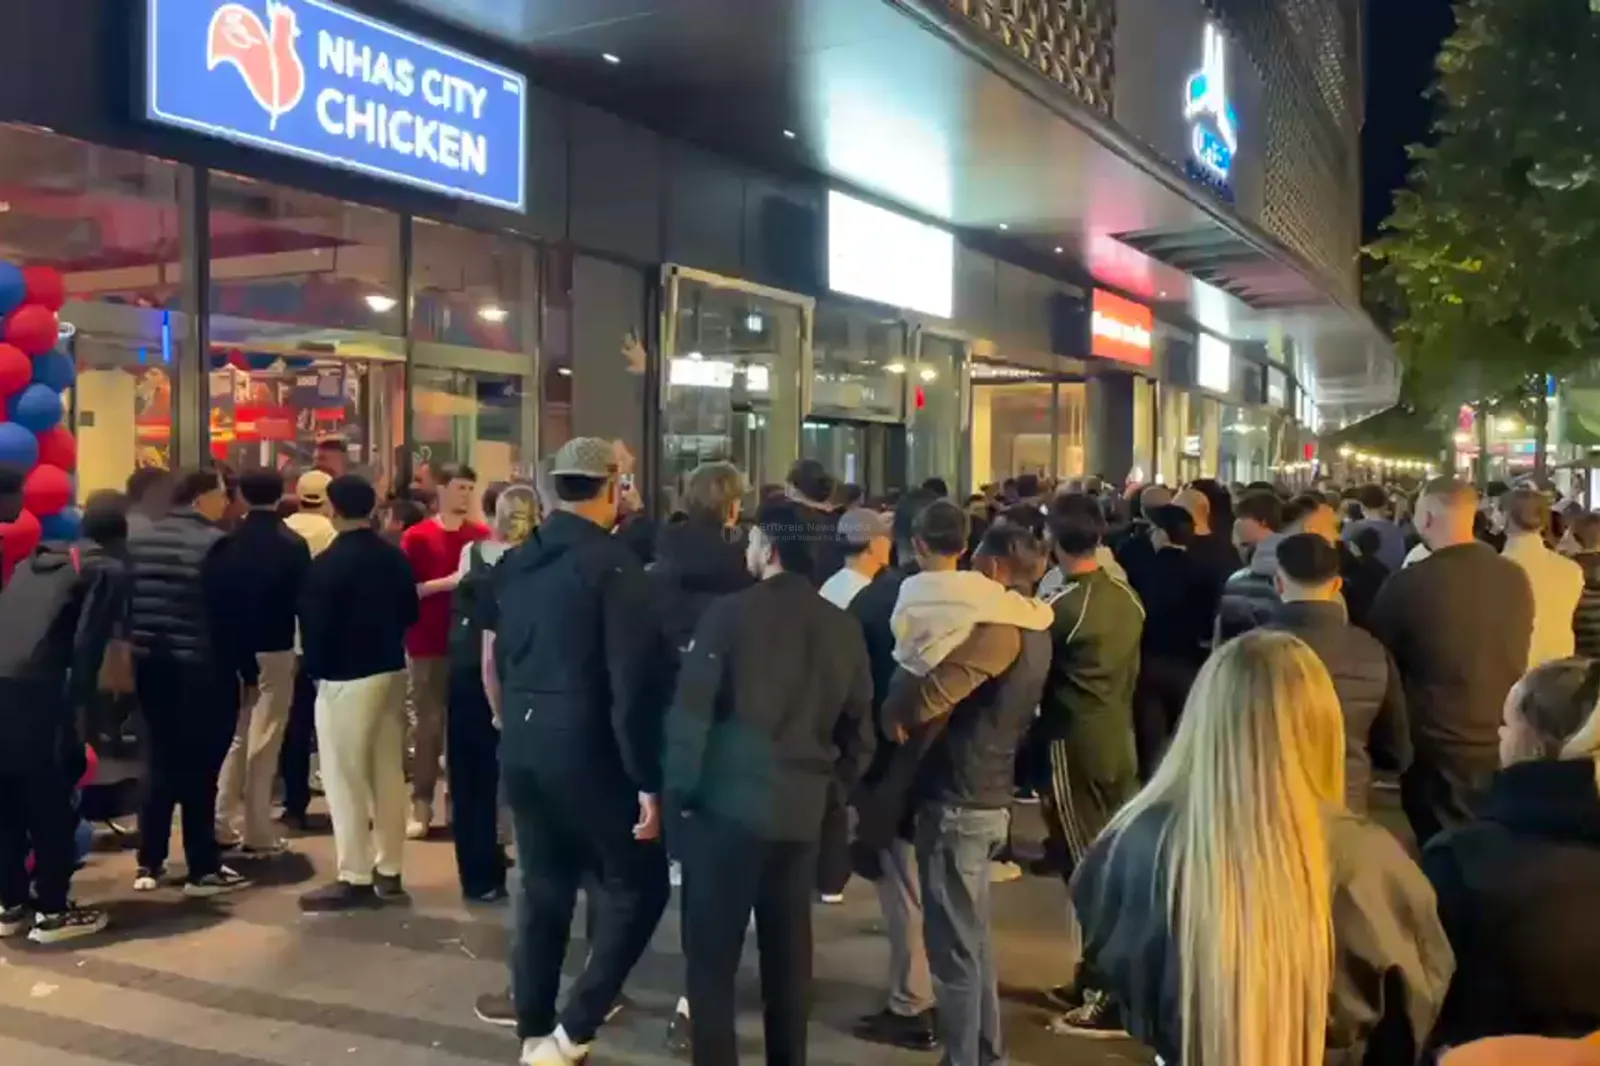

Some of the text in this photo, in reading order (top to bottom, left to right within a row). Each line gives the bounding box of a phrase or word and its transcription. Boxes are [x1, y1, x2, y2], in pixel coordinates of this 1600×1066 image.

[318, 29, 488, 119] NHAS CITY
[316, 88, 487, 176] CHICKEN
